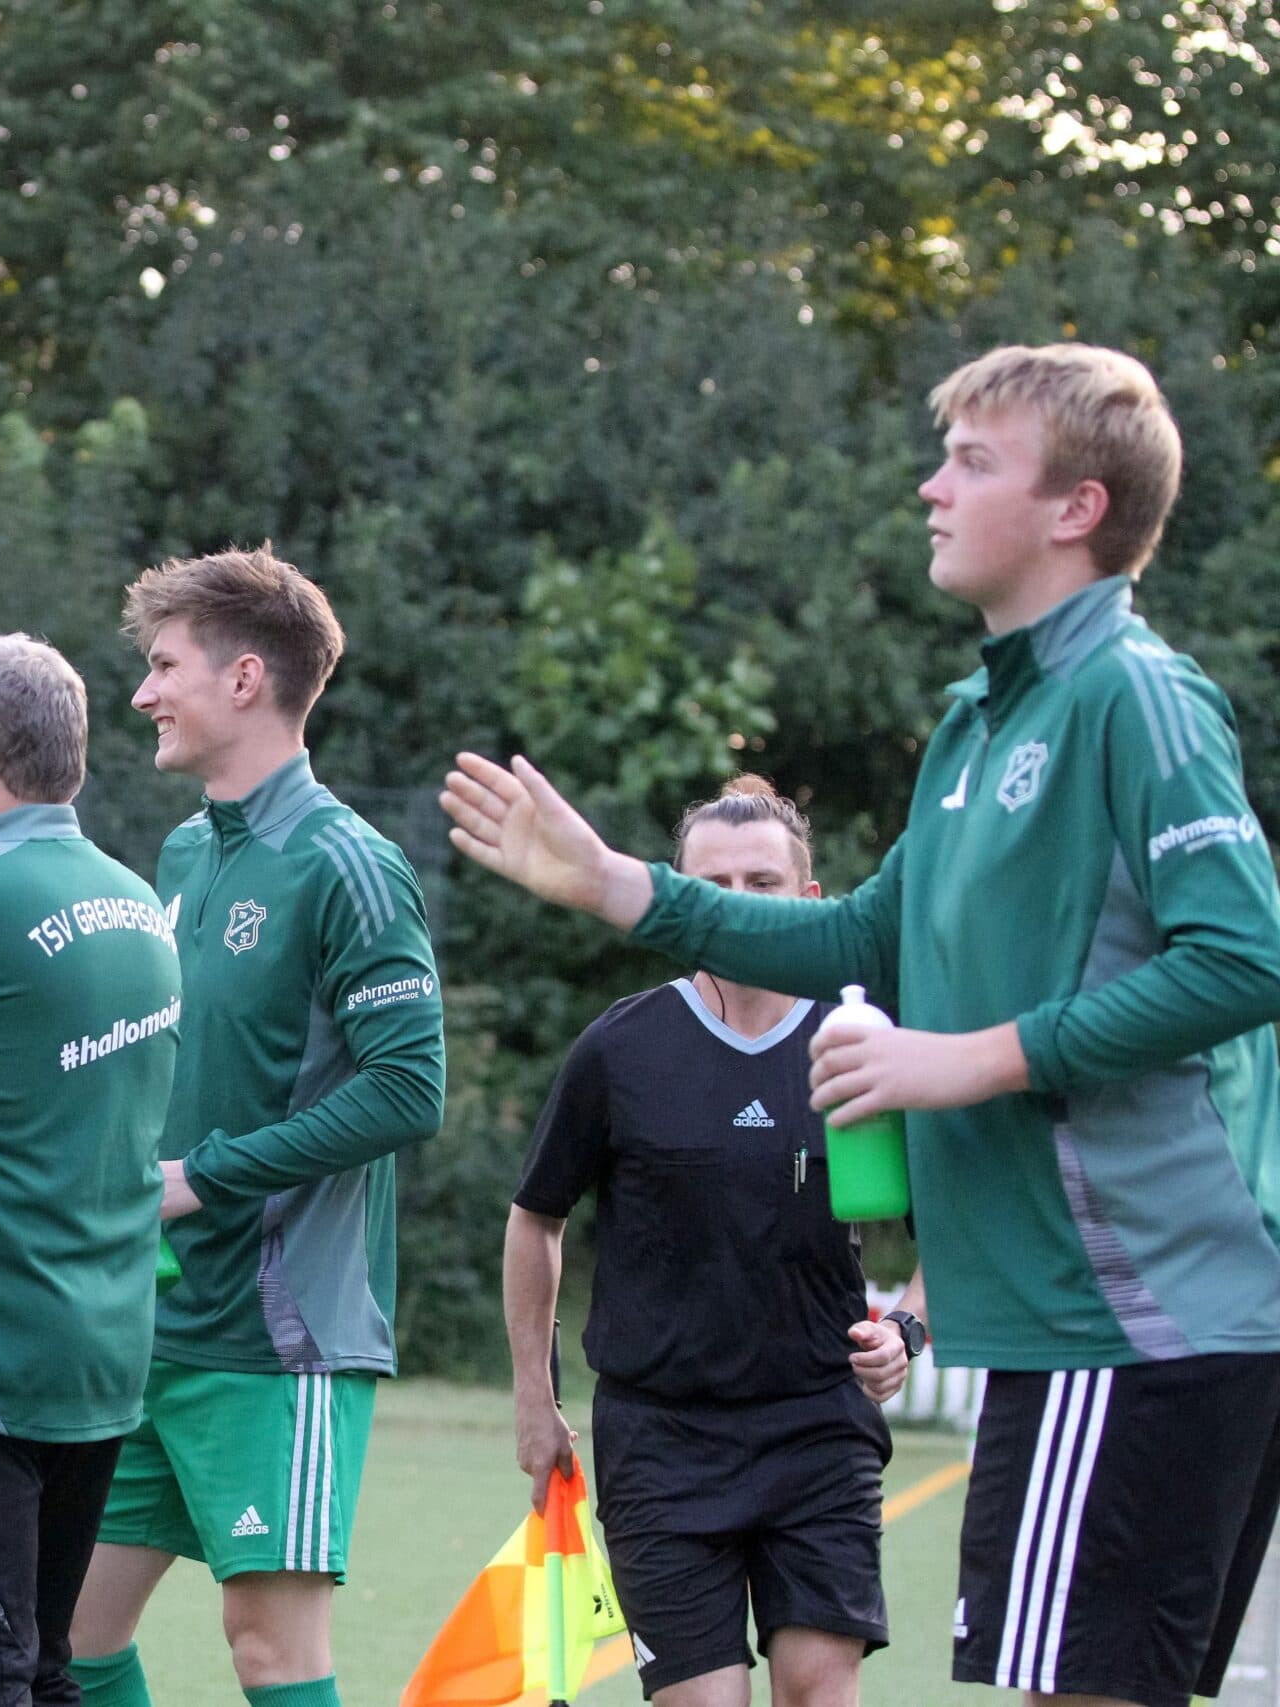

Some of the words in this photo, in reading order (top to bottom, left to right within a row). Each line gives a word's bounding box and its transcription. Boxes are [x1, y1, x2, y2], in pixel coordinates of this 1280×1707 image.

[27, 909, 73, 957] TSV
[72, 898, 178, 955] GREMERSDOR
[347, 977, 420, 1010] gehrmann
[733, 1116, 775, 1127] adidas
[231, 1524, 269, 1536] adidas
